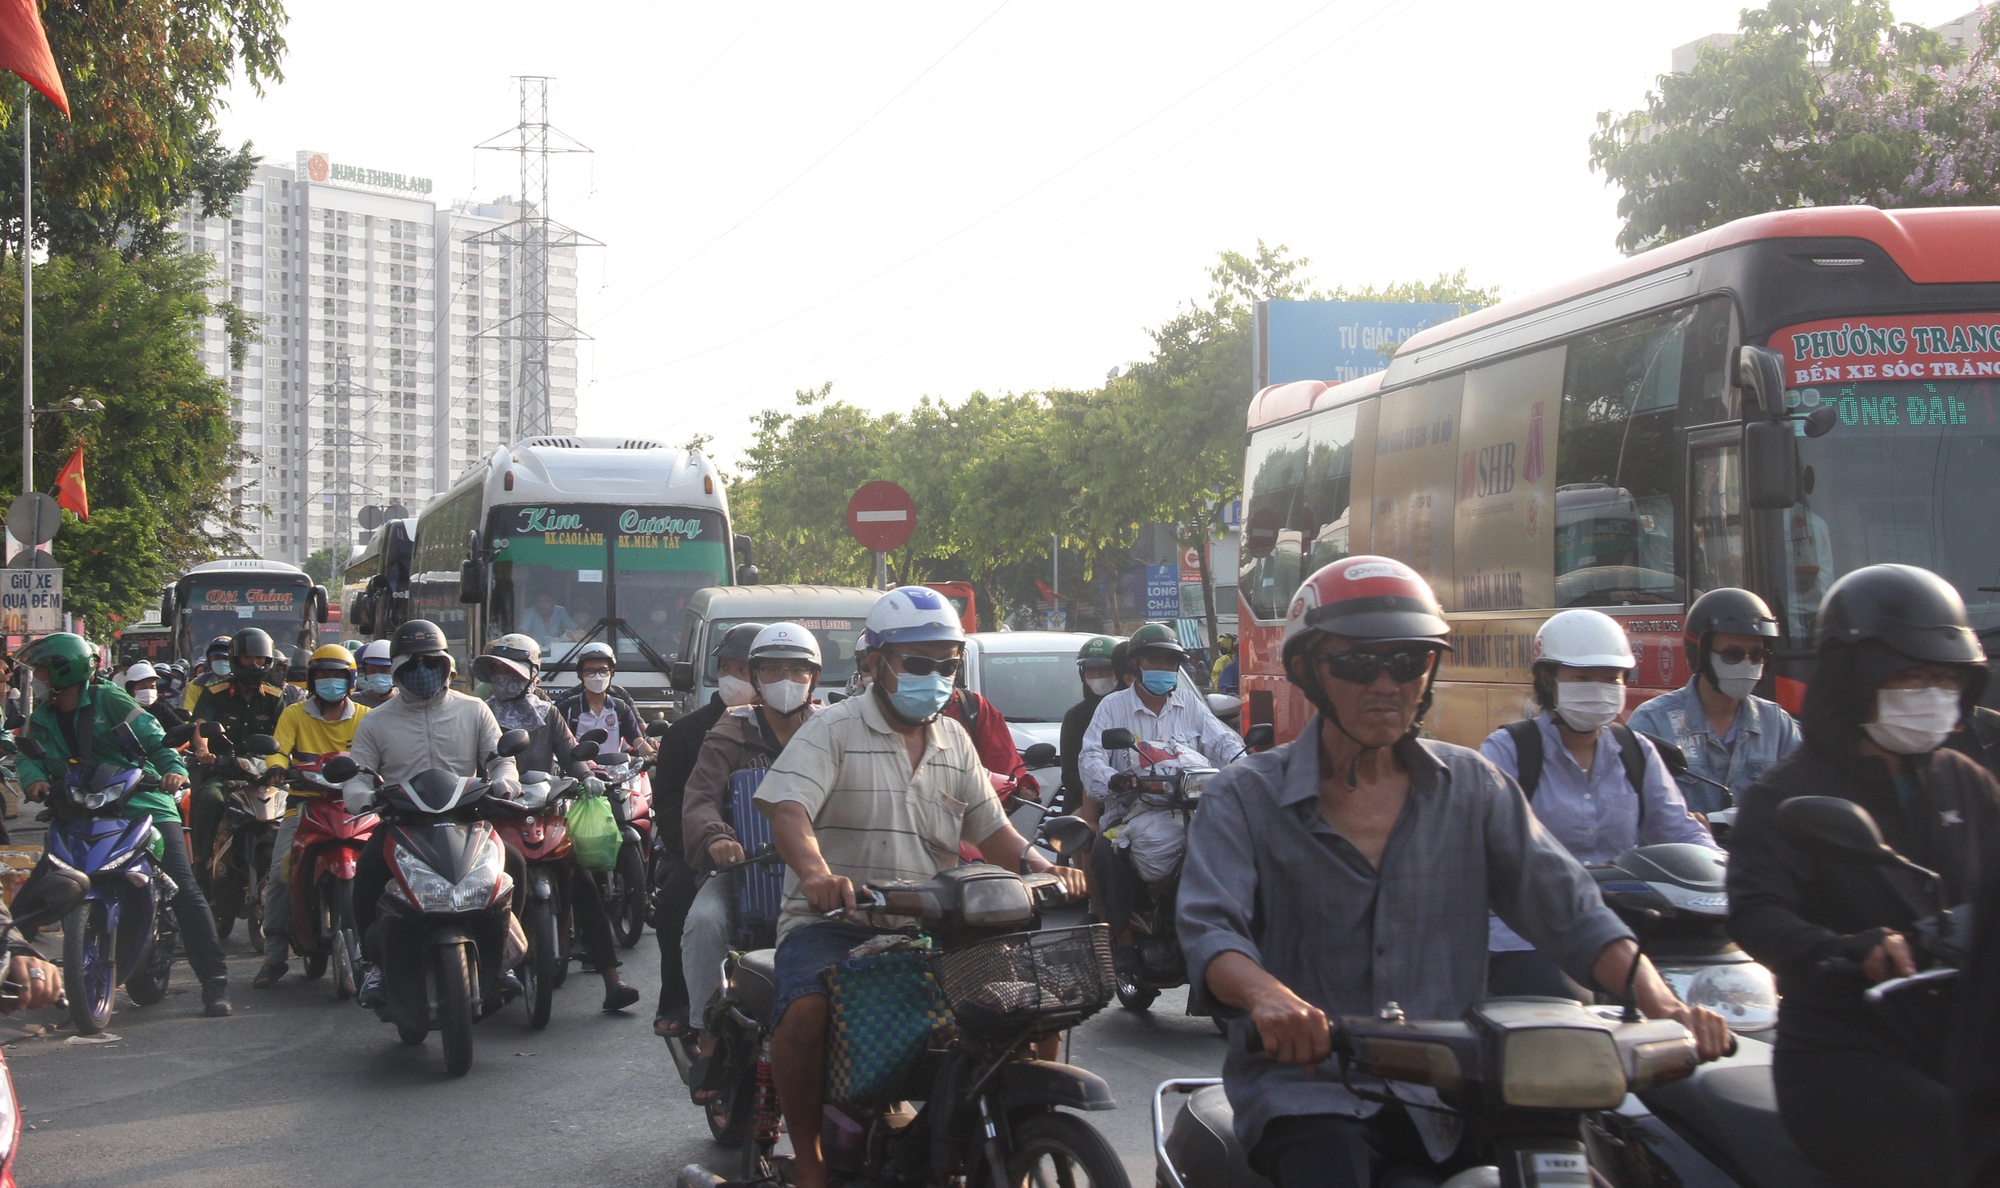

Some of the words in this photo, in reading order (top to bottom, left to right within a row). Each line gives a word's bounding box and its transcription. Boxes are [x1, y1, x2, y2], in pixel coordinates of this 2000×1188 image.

[1339, 322, 1359, 355] TỰ
[1792, 323, 1907, 361] PHƯƠNG
[1795, 362, 1840, 383] BẾN
[1846, 364, 1877, 379] XE
[1882, 360, 1924, 377] SÓC
[1906, 383, 1967, 425] ĐÀI:
[1478, 442, 1516, 498] SHB
[516, 508, 583, 532] Kim
[619, 509, 702, 540] Cương
[662, 533, 681, 549] TÂY
[36, 574, 52, 589] XE
[1147, 587, 1178, 597] LONG
[2, 593, 28, 611] QUA
[32, 589, 60, 609] ĐÊM
[1147, 598, 1179, 609] CHÂU
[785, 618, 820, 630] ÁCH
[821, 620, 851, 630] LONG
[1517, 634, 1536, 669] NA
